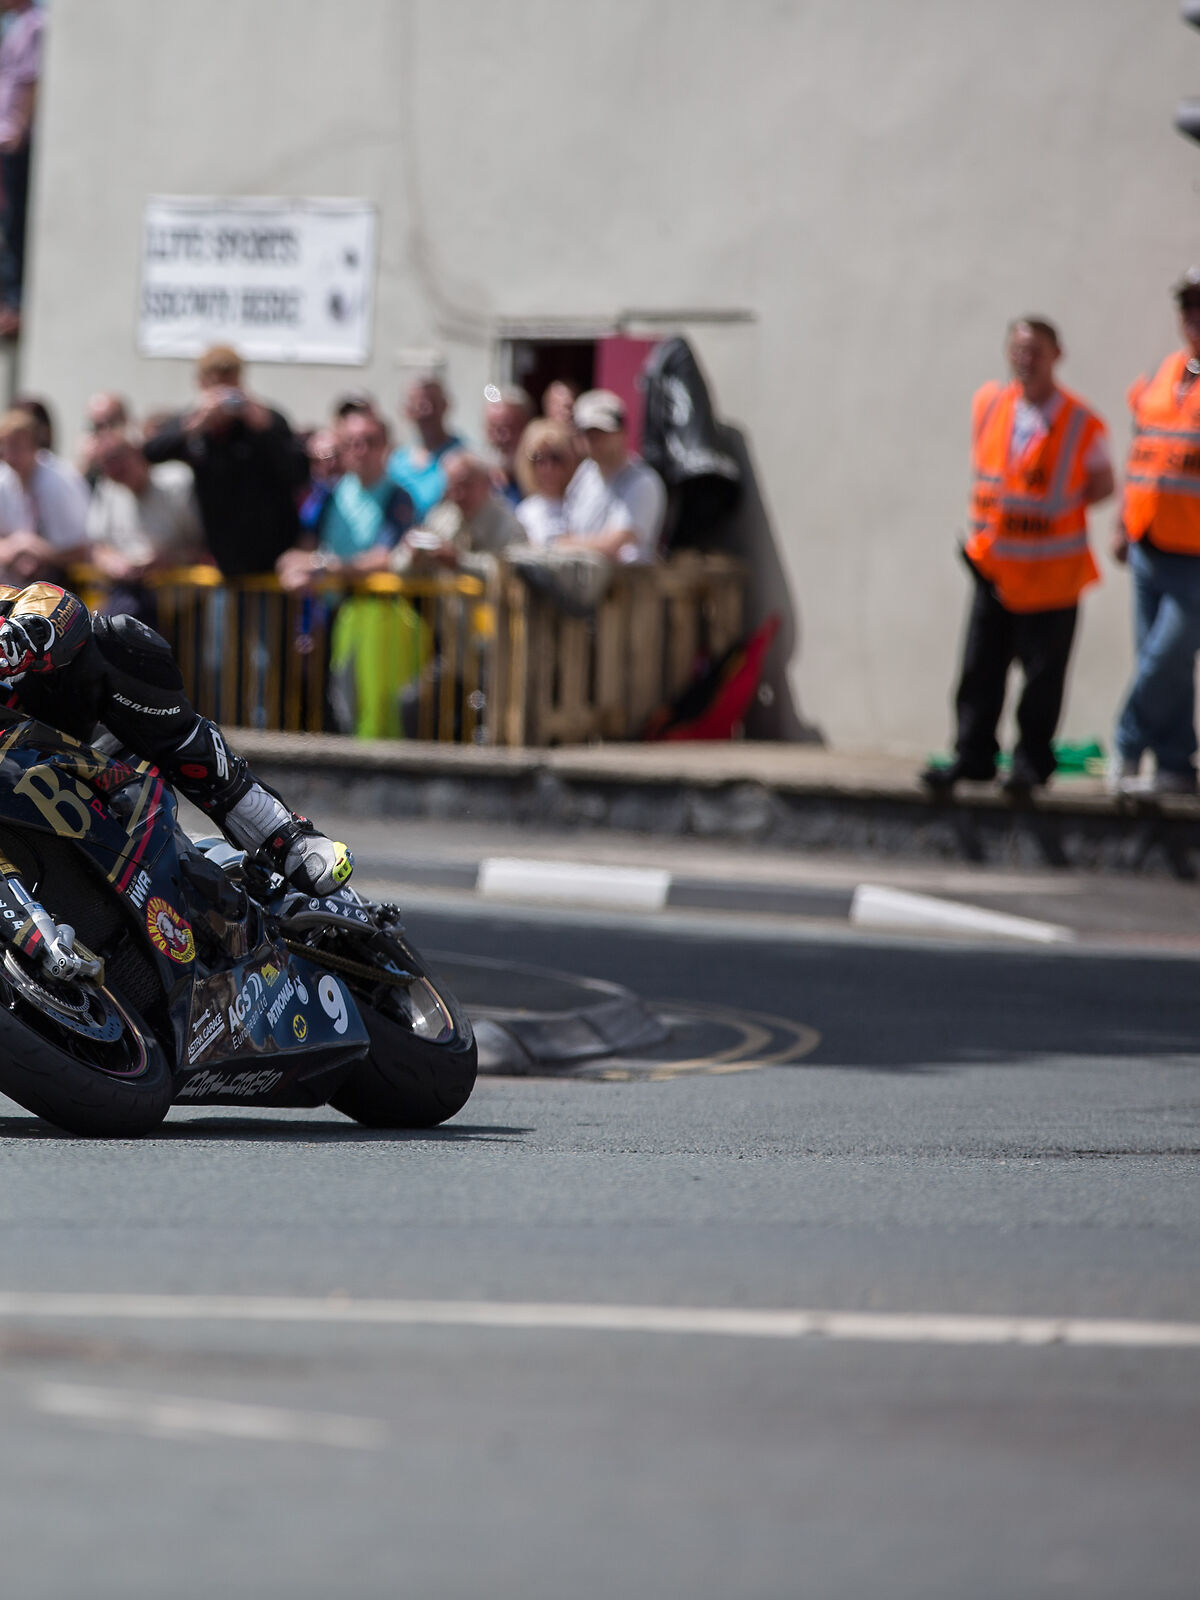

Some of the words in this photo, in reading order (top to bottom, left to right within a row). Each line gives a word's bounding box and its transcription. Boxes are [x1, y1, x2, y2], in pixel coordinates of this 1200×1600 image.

[131, 703, 181, 716] RACING
[266, 977, 295, 1029] PETRONAS
[318, 974, 349, 1034] 9
[188, 1034, 204, 1058] ASTRA
